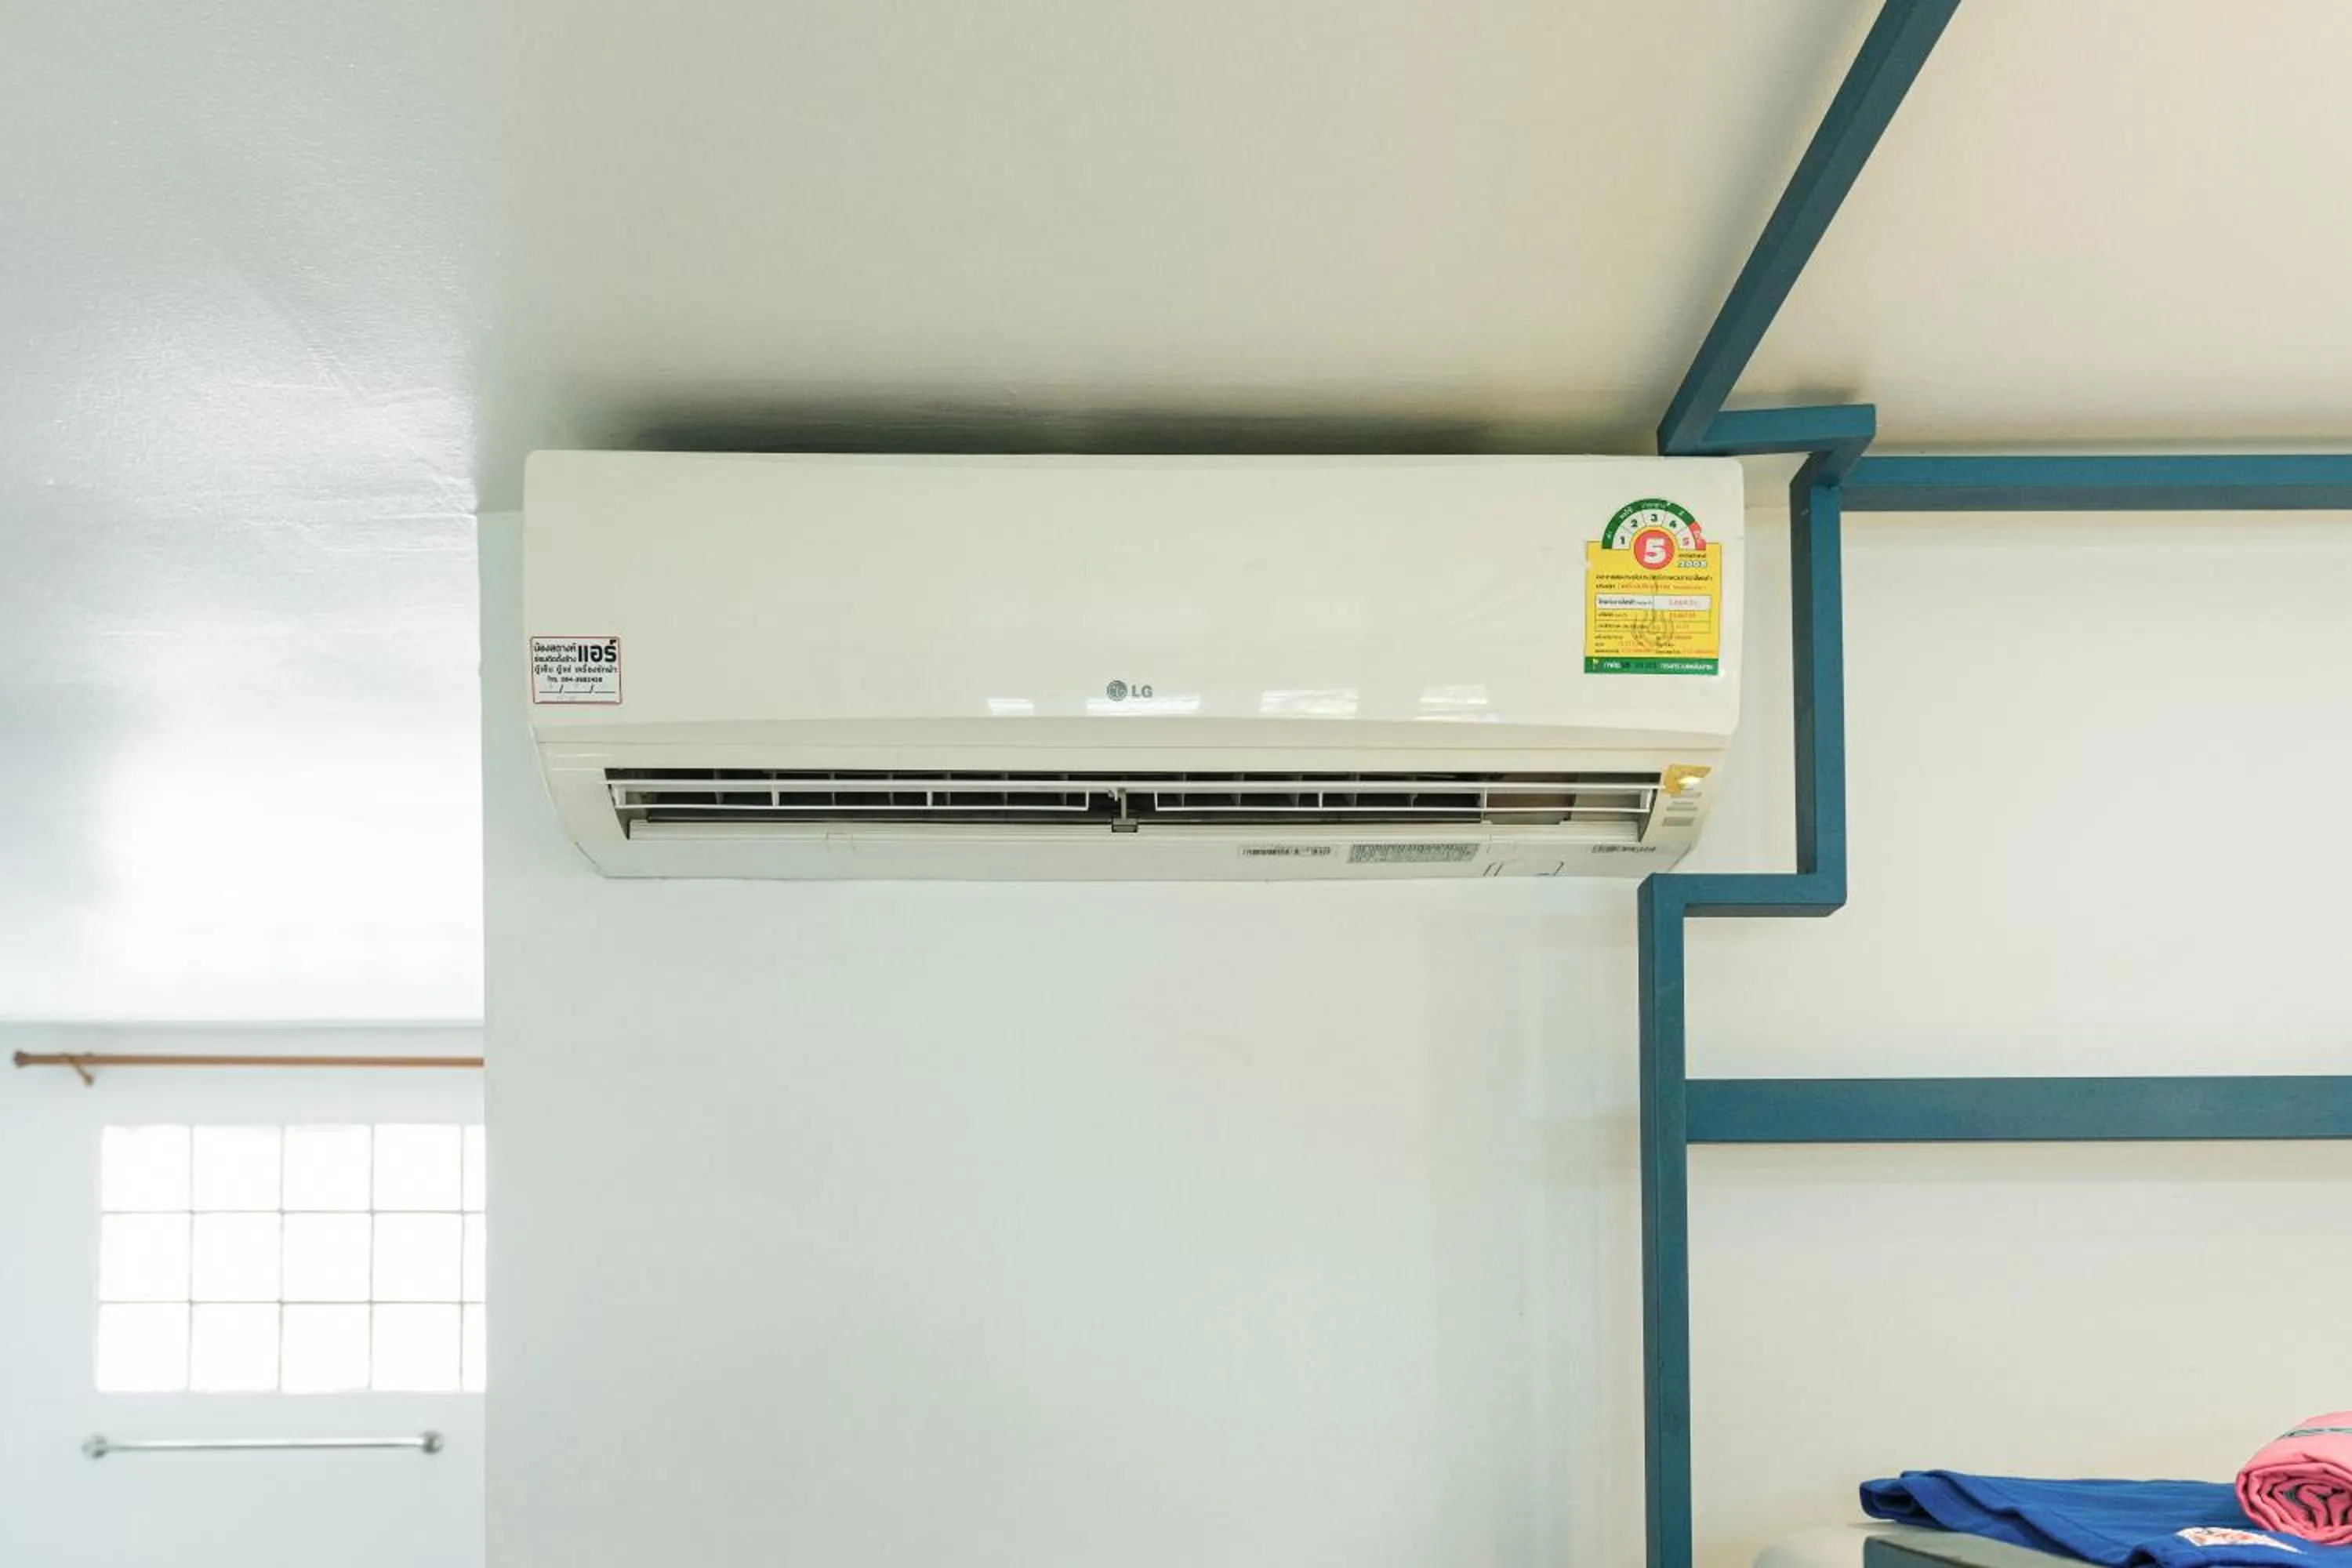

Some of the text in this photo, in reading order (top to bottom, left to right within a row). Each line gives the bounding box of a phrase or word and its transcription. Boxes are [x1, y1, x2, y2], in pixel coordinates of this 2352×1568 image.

[1620, 514, 1690, 546] 1 2 3 4 5
[1643, 537, 1667, 564] 5
[578, 639, 617, 662] แอร์
[1131, 684, 1153, 699] LG
